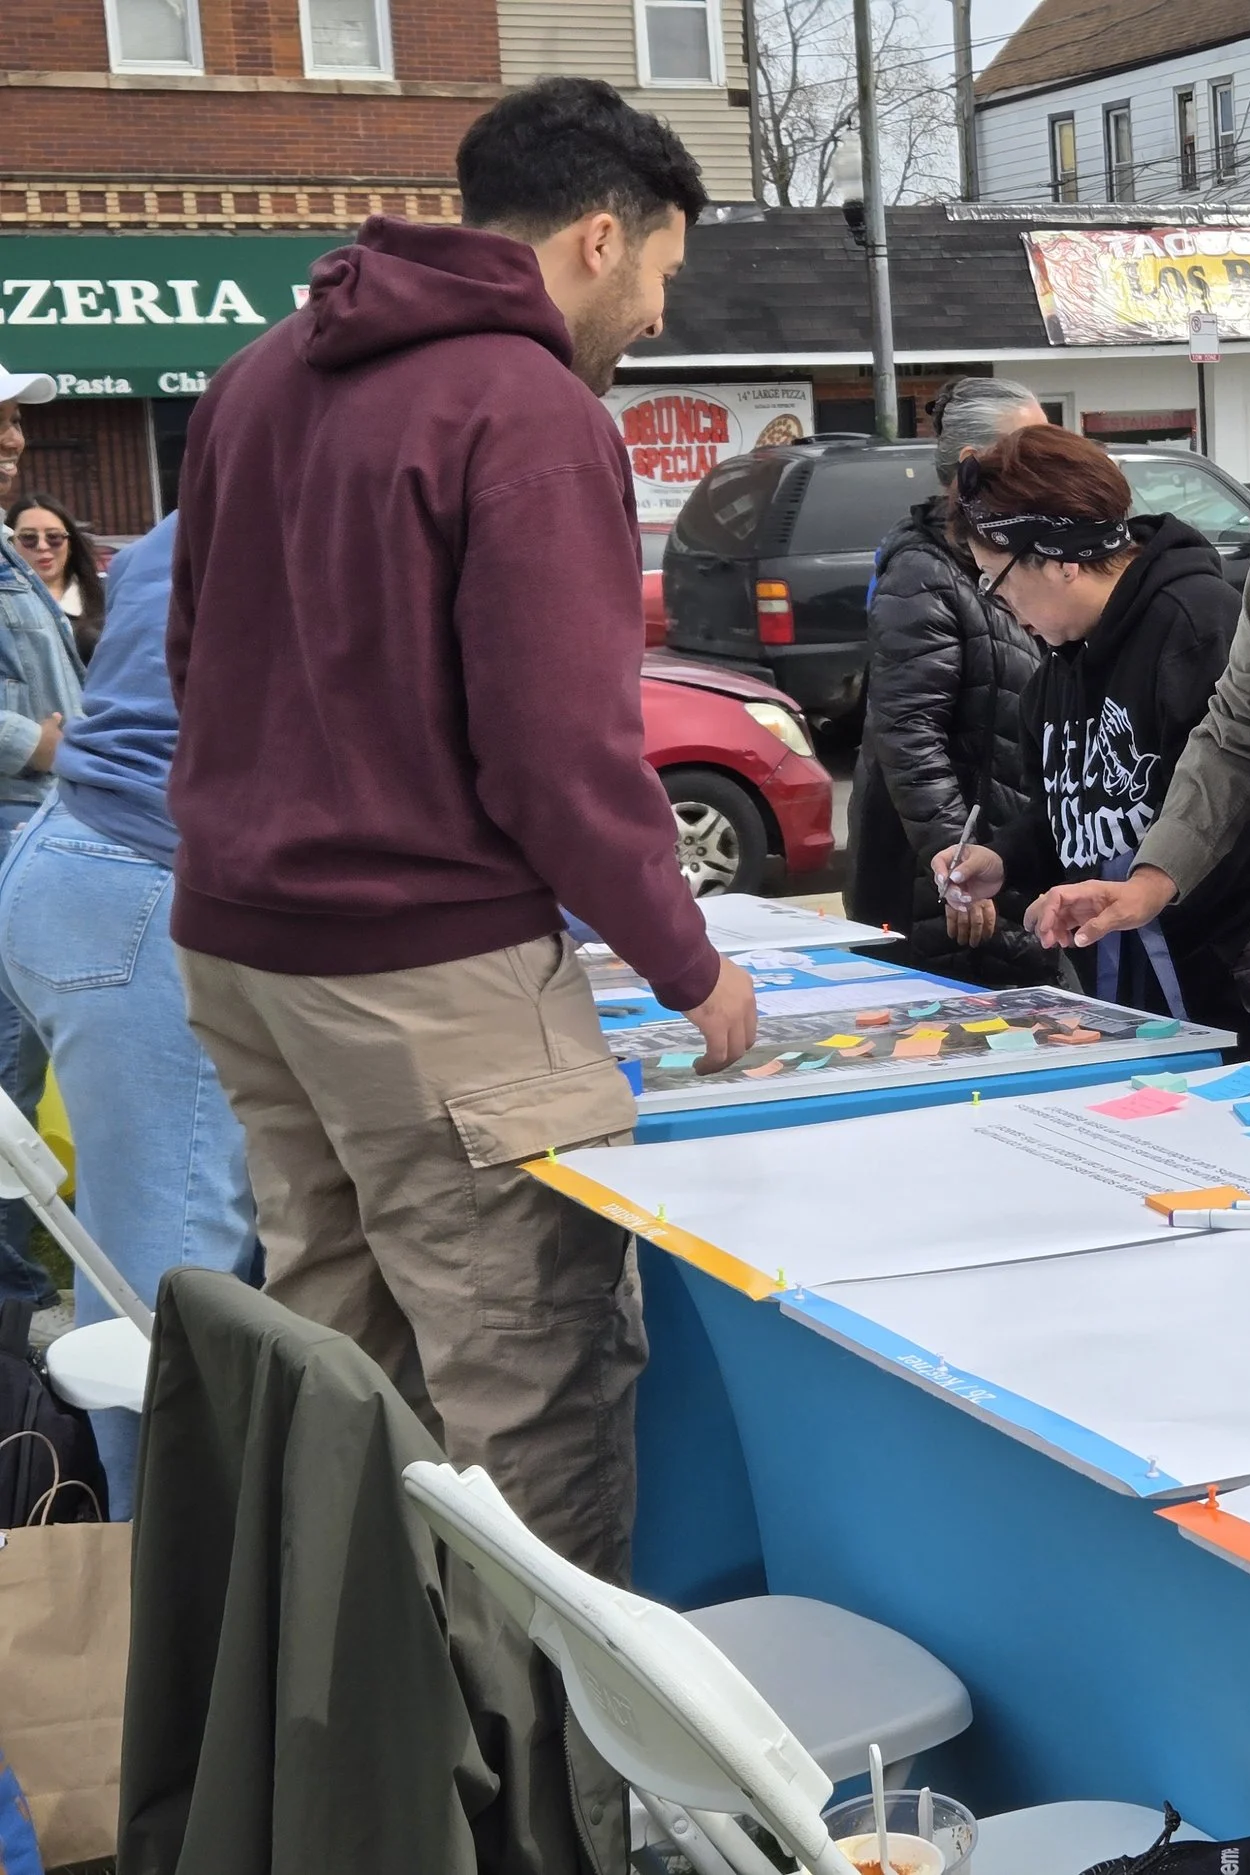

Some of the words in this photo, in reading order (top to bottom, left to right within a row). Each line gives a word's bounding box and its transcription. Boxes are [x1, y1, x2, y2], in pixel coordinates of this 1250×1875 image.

[0, 279, 267, 325] ZERIA
[56, 372, 133, 395] Pasta
[158, 371, 210, 393] Chi
[752, 388, 780, 400] LARGE
[781, 388, 807, 401] PIZZA
